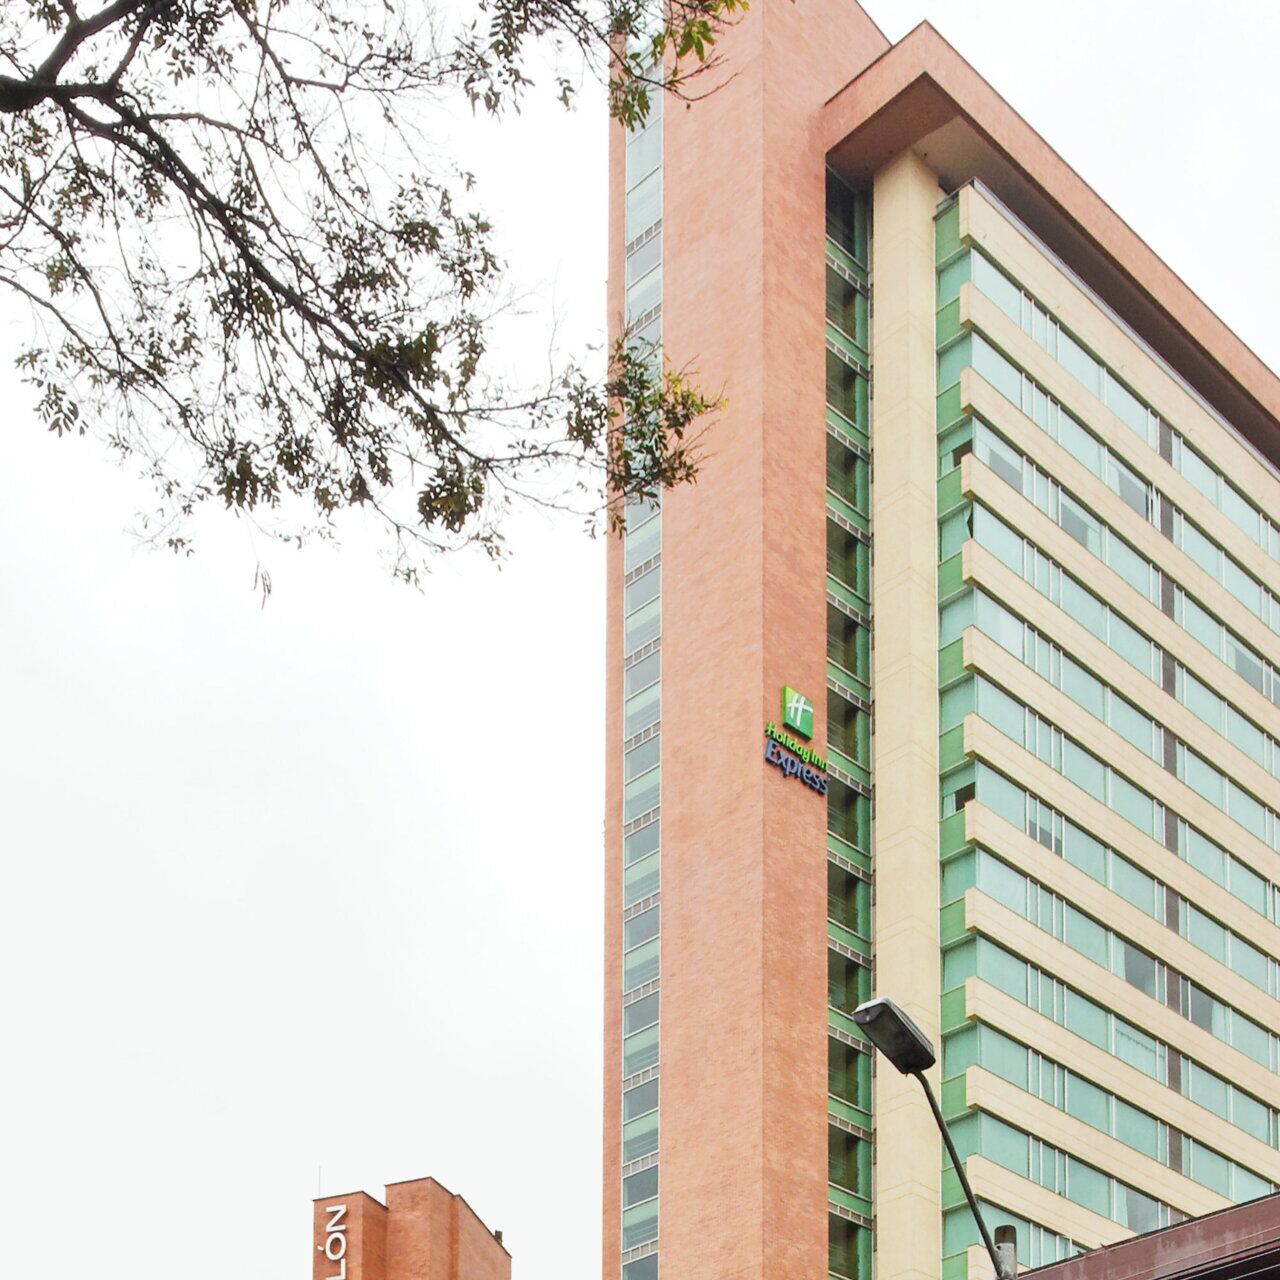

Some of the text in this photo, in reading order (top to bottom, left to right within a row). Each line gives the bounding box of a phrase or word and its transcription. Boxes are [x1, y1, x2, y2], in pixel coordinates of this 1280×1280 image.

[765, 721, 828, 772] Holiday Inn
[765, 740, 830, 796] Express
